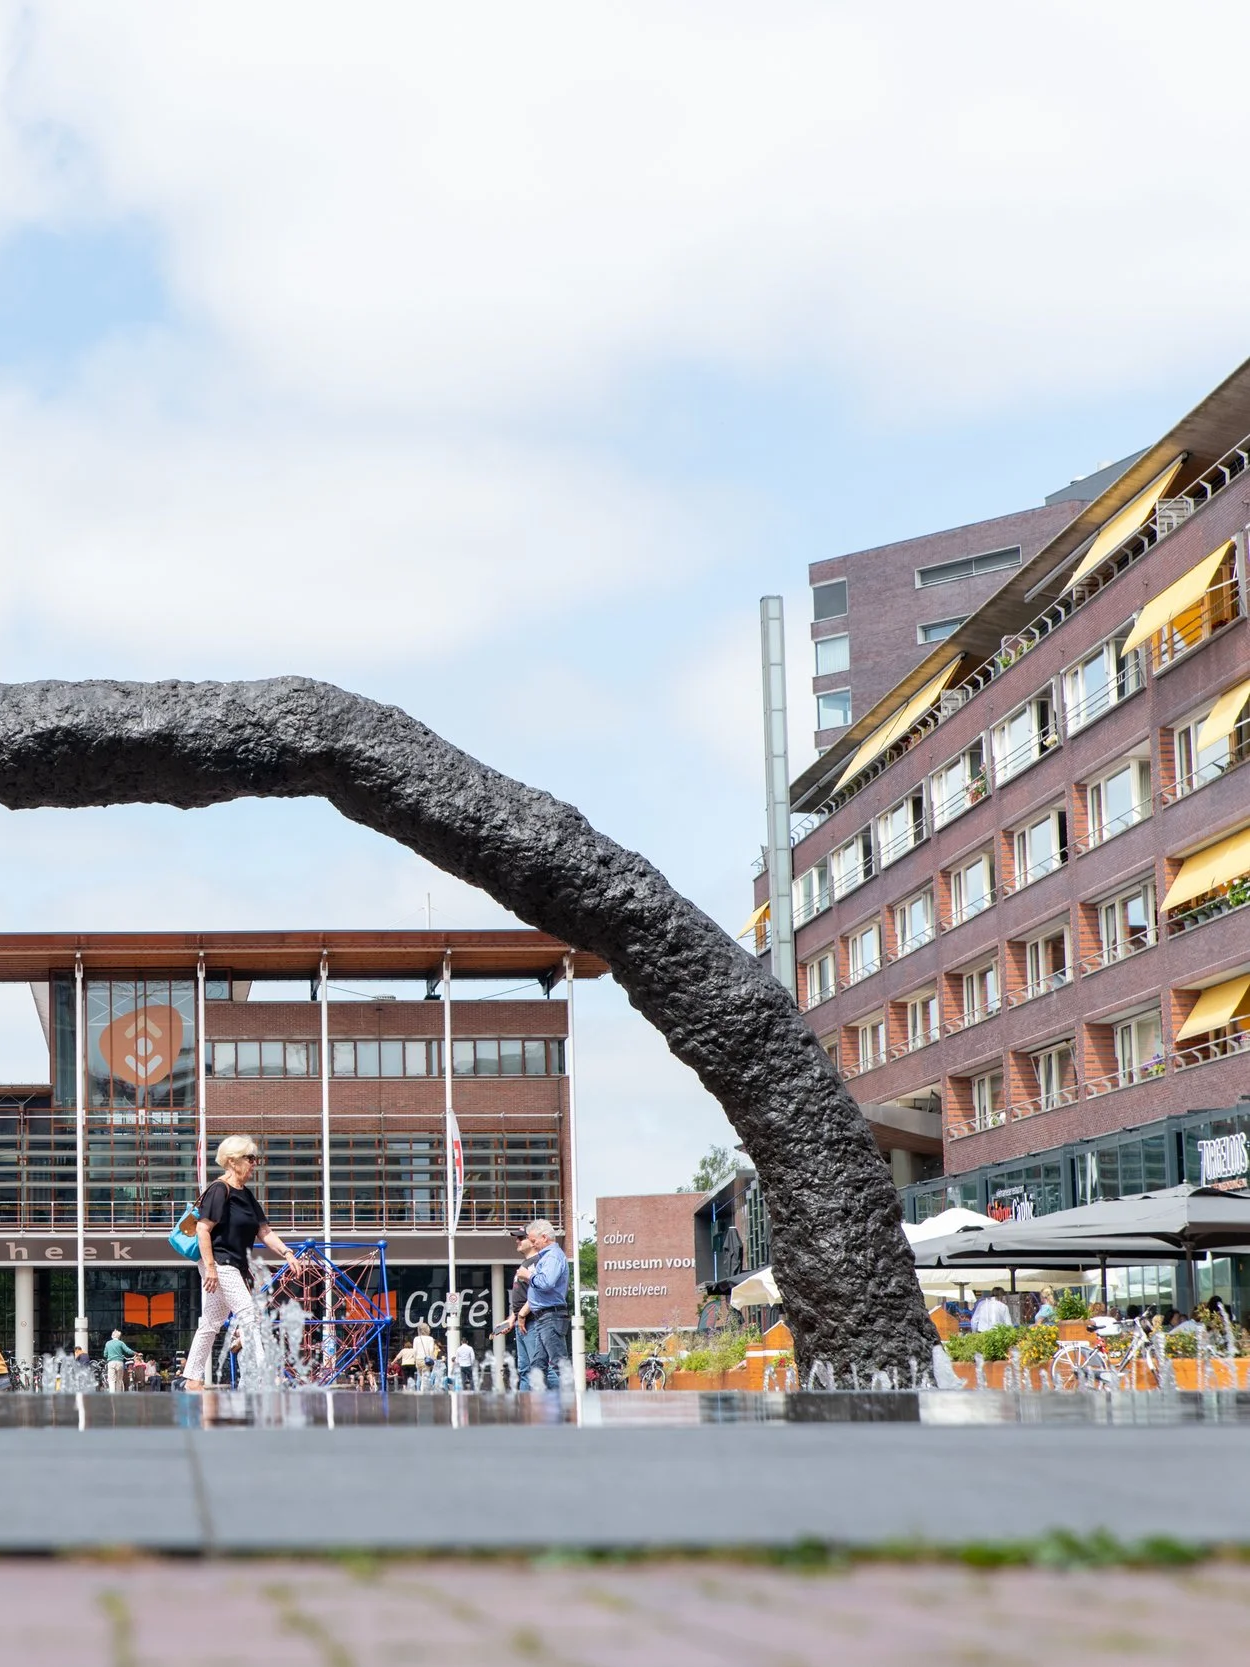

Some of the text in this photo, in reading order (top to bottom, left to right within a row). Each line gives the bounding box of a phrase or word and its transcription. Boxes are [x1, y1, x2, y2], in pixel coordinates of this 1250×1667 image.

[1197, 1131, 1248, 1188] ZORGELOOS
[603, 1230, 635, 1244] cobra
[604, 1258, 663, 1270] museum
[605, 1283, 667, 1297] amstelveen
[404, 1288, 490, 1329] Café
